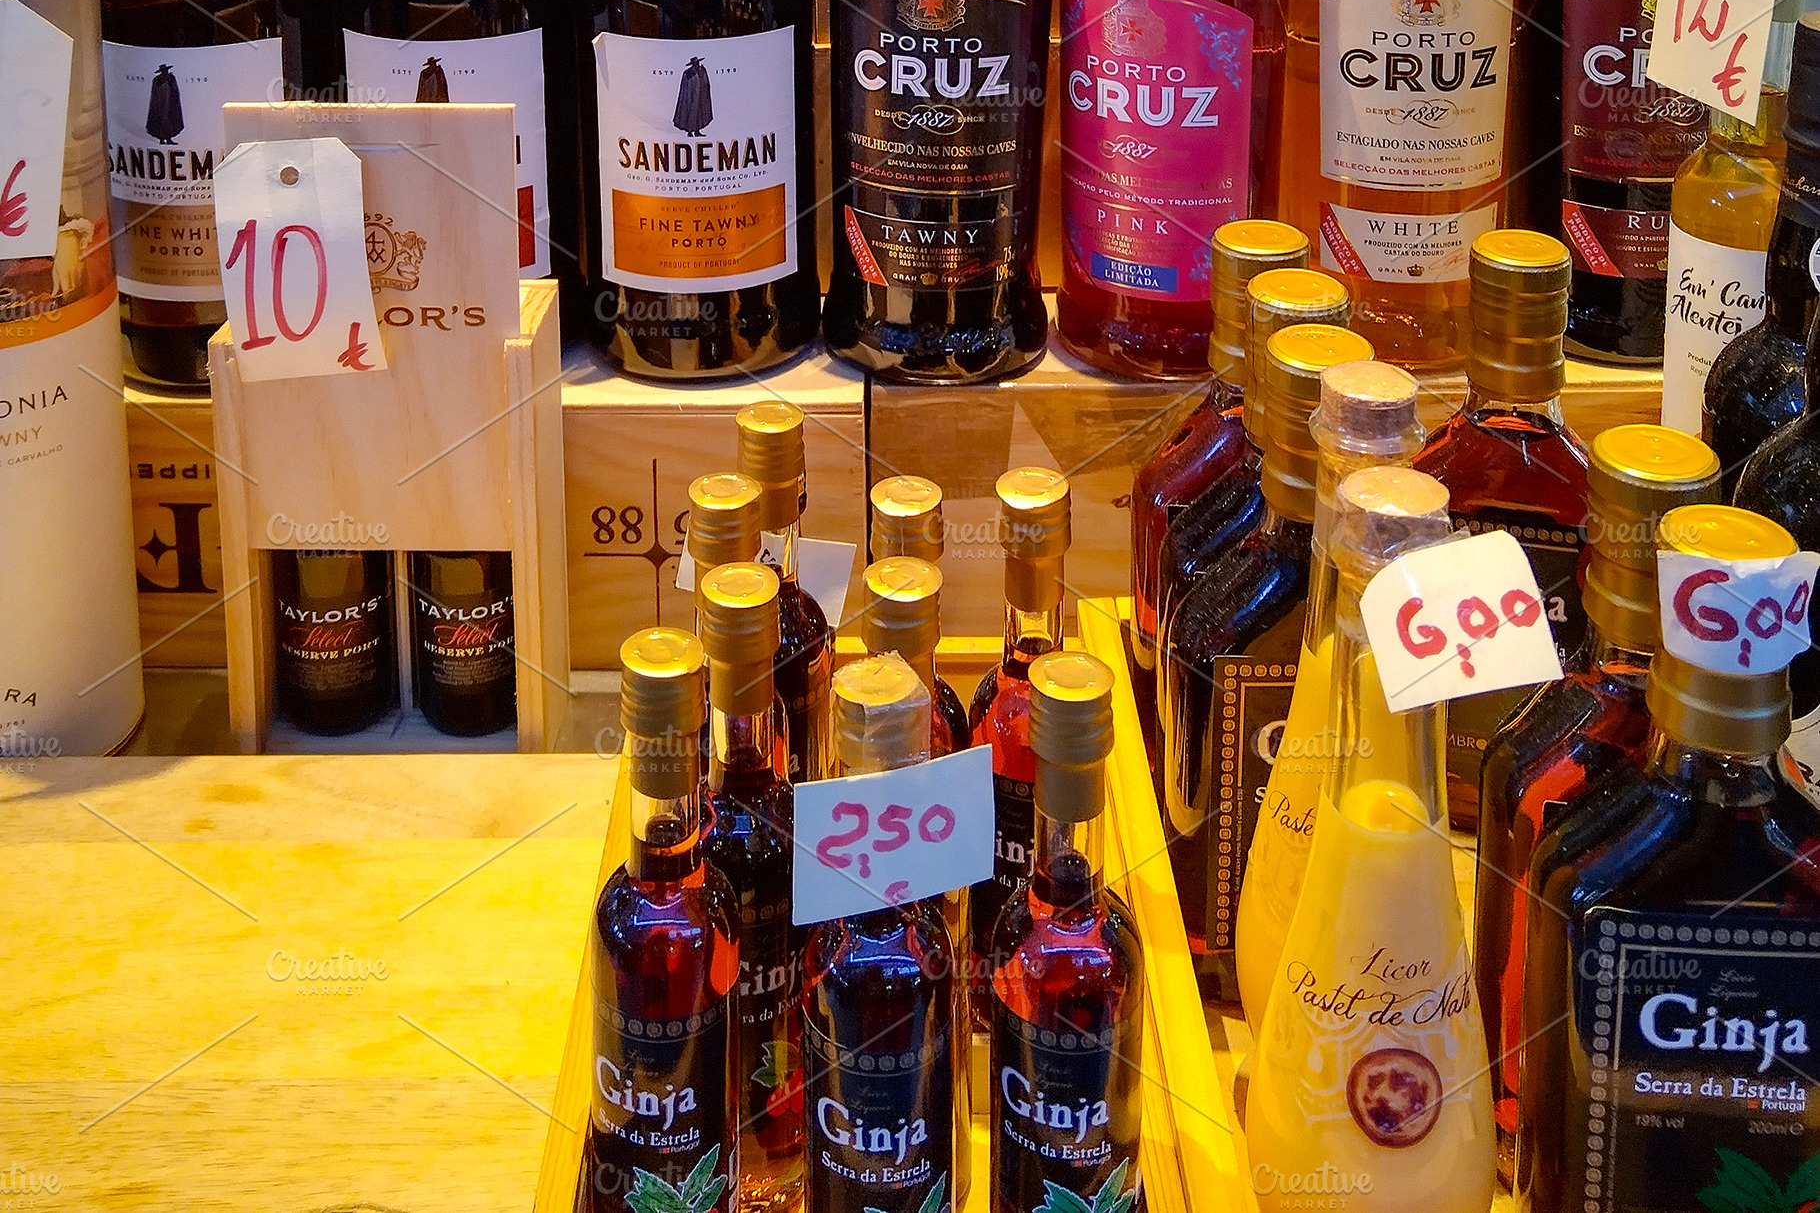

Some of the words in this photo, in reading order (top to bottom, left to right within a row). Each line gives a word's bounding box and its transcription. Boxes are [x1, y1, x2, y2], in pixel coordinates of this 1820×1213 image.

[879, 31, 983, 54] PORTO
[1371, 31, 1476, 48] PORTO
[854, 48, 1011, 99] CRUZ
[1086, 54, 1187, 83] PORTO
[1339, 45, 1498, 93] CRUZ
[1068, 69, 1220, 128] CRUZ
[917, 144, 939, 157] NAS
[942, 146, 985, 158] NOSSAS
[986, 139, 1017, 155] CAVES
[1111, 141, 1158, 159] 1887
[1336, 130, 1400, 150] ESTAGIADO
[1402, 140, 1426, 151] NAS
[1428, 137, 1468, 151] NOSSAS
[1470, 130, 1496, 146] CAVES
[618, 132, 777, 174] SANDEMAN
[895, 172, 915, 181] DAS
[917, 173, 972, 184] MELHORES
[1389, 168, 1409, 176] DAS
[1412, 166, 1466, 176] MELHORES
[695, 183, 742, 192] PORTUGAL
[1098, 188, 1121, 199] PELO
[1168, 196, 1233, 206] TRADICIONAL
[639, 217, 683, 232] FINE
[692, 214, 758, 232] TAWNY
[1096, 208, 1169, 235] PINK
[1367, 219, 1459, 237] WHITE
[671, 237, 728, 250] PORTO
[881, 224, 979, 246] TAWNY
[150, 246, 204, 257] PORTO
[1104, 269, 1160, 288] LIMITADA
[1110, 260, 1152, 277] EDIÇÃO
[225, 218, 329, 351] 10
[7, 444, 63, 467] CARVALHO
[591, 505, 644, 544] 88
[278, 595, 382, 624] TAYLOR'S
[1639, 992, 1810, 1073] Ginja
[596, 1055, 698, 1131] Ginja
[1634, 1072, 1693, 1095] Serra
[1700, 1077, 1723, 1097] da
[1731, 1077, 1806, 1101] Estrela
[1001, 1066, 1110, 1143] Ginja
[1762, 1098, 1806, 1114] Portugal
[599, 1108, 626, 1138] Serra
[629, 1132, 645, 1146] da
[650, 1128, 699, 1147] Estrela
[817, 1096, 928, 1165] Ginja
[1004, 1119, 1036, 1151] Serra
[1040, 1142, 1056, 1158] da
[1061, 1140, 1112, 1159] Estrela
[821, 1150, 856, 1179] Serra
[860, 1168, 876, 1182] da
[882, 1158, 931, 1182] Estrela
